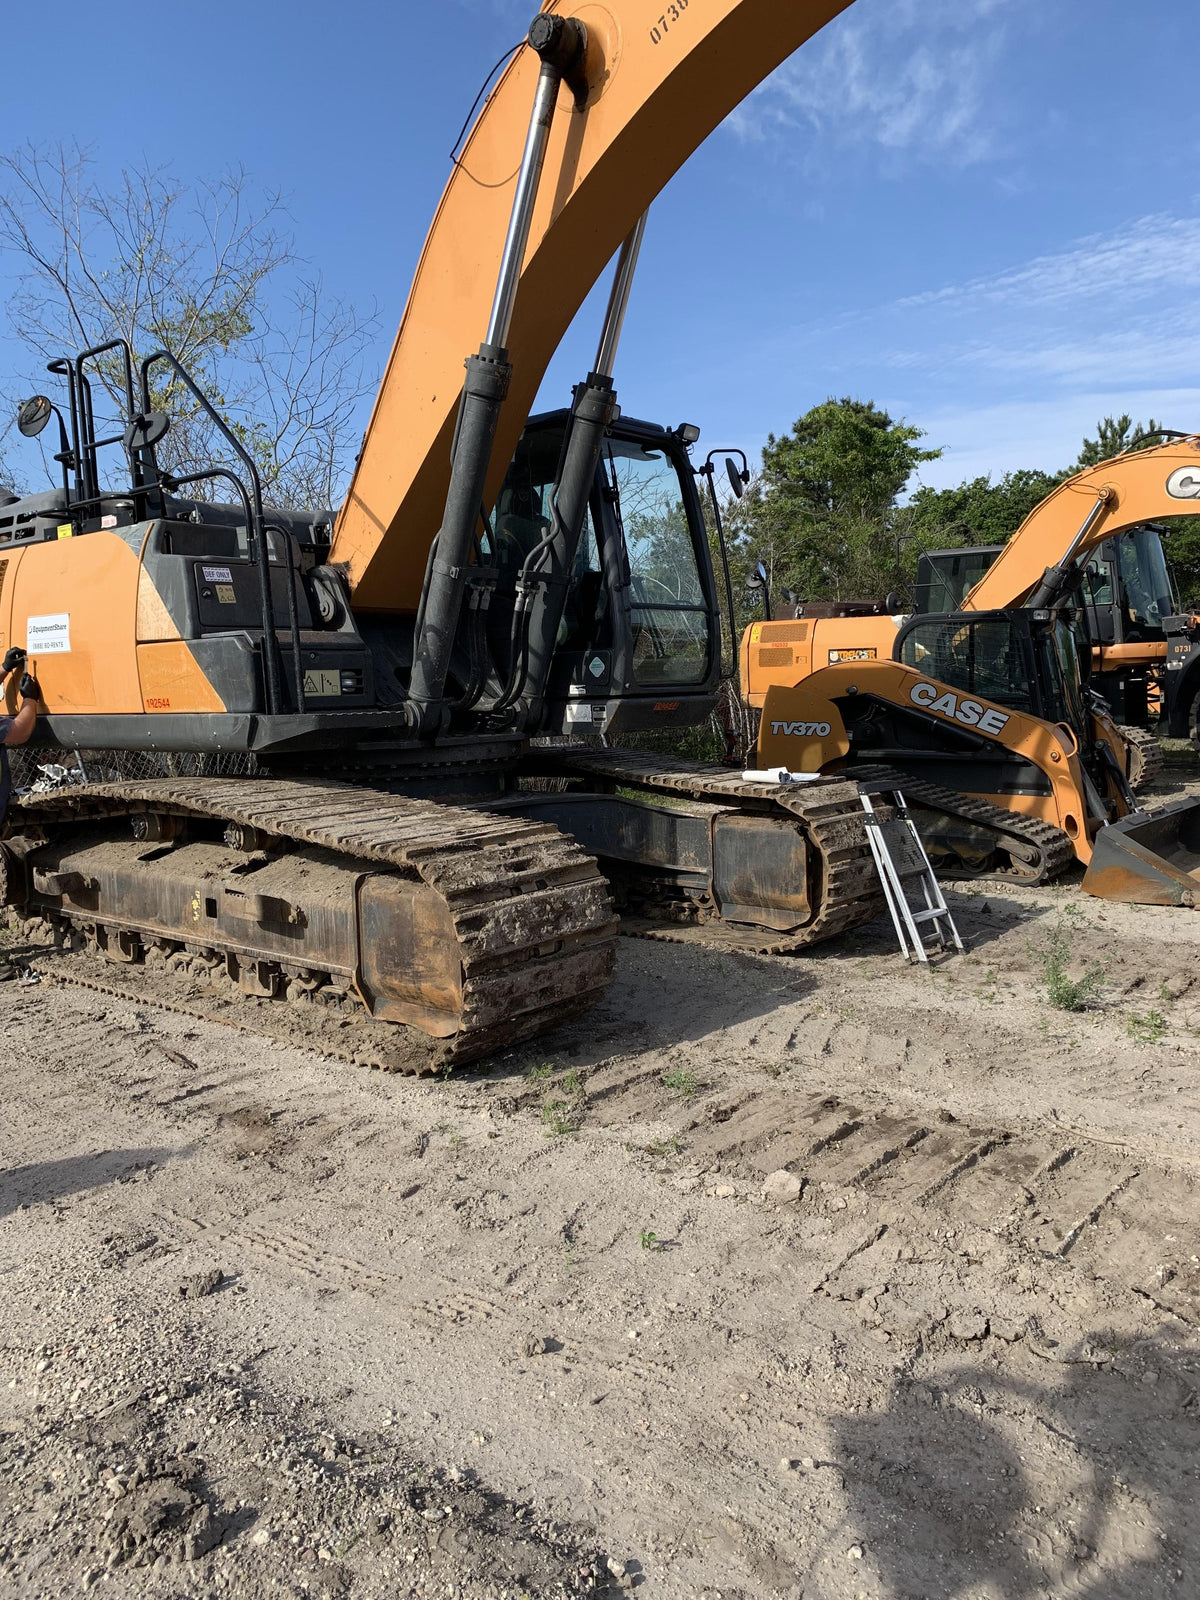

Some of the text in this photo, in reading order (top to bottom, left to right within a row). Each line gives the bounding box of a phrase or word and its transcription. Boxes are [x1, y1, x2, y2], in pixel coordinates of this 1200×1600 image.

[1165, 464, 1200, 499] C
[216, 570, 231, 579] ONLY
[146, 698, 170, 708] 192544
[909, 681, 1010, 736] CASE
[770, 720, 831, 737] TV370
